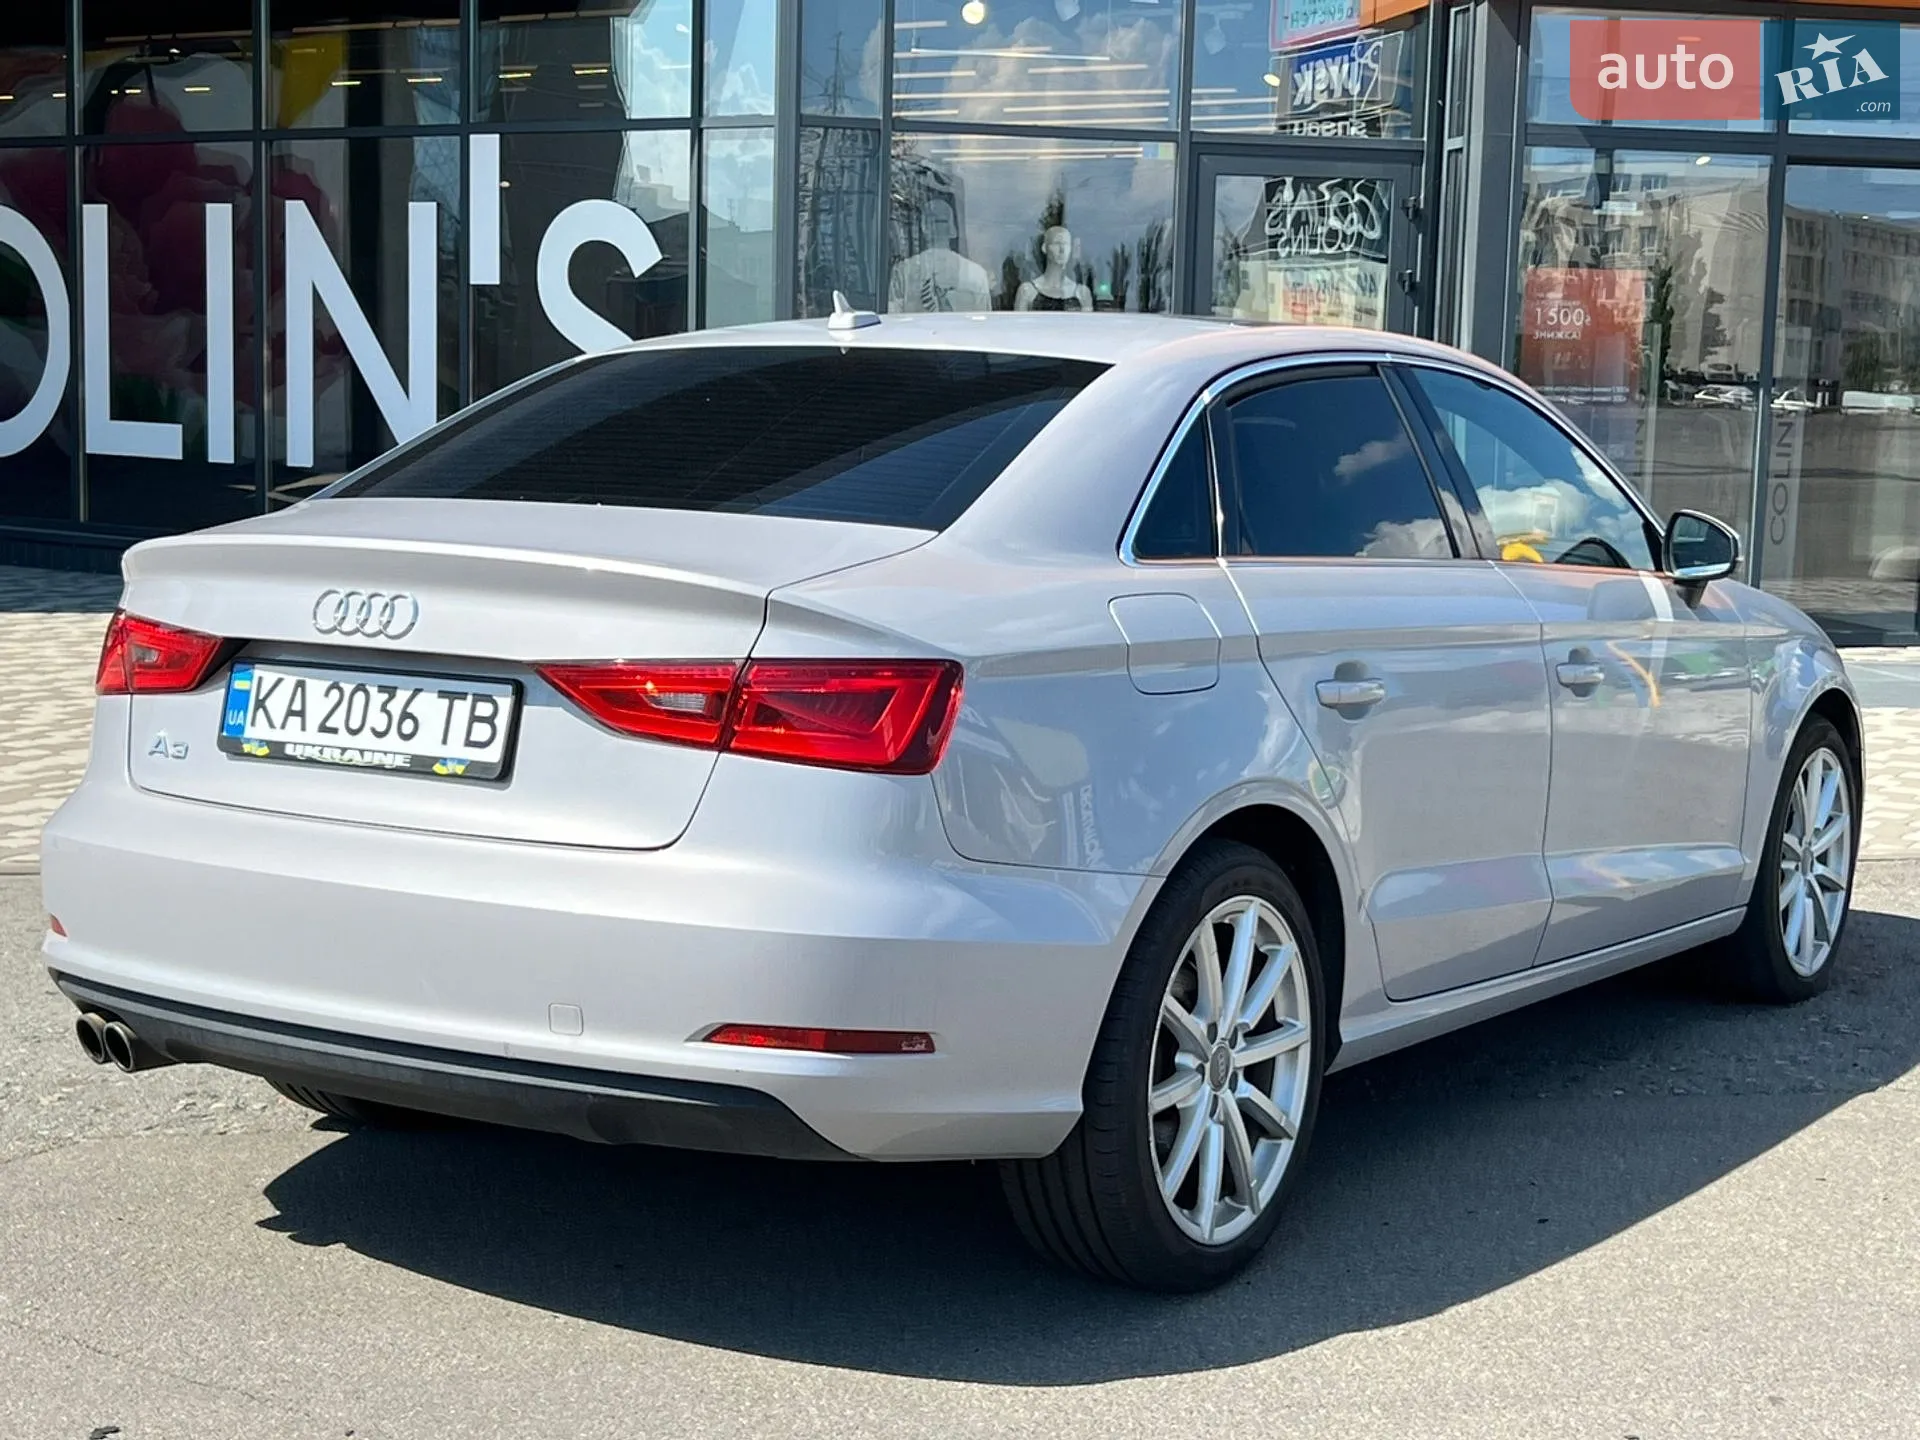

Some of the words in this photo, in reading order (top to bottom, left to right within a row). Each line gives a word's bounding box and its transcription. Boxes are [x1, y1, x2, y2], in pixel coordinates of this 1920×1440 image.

[228, 709, 245, 725] UA
[250, 675, 307, 733] KA
[317, 681, 424, 743] 2036
[436, 689, 500, 750] TB
[148, 730, 189, 760] A3
[284, 742, 412, 769] UKRAINE
